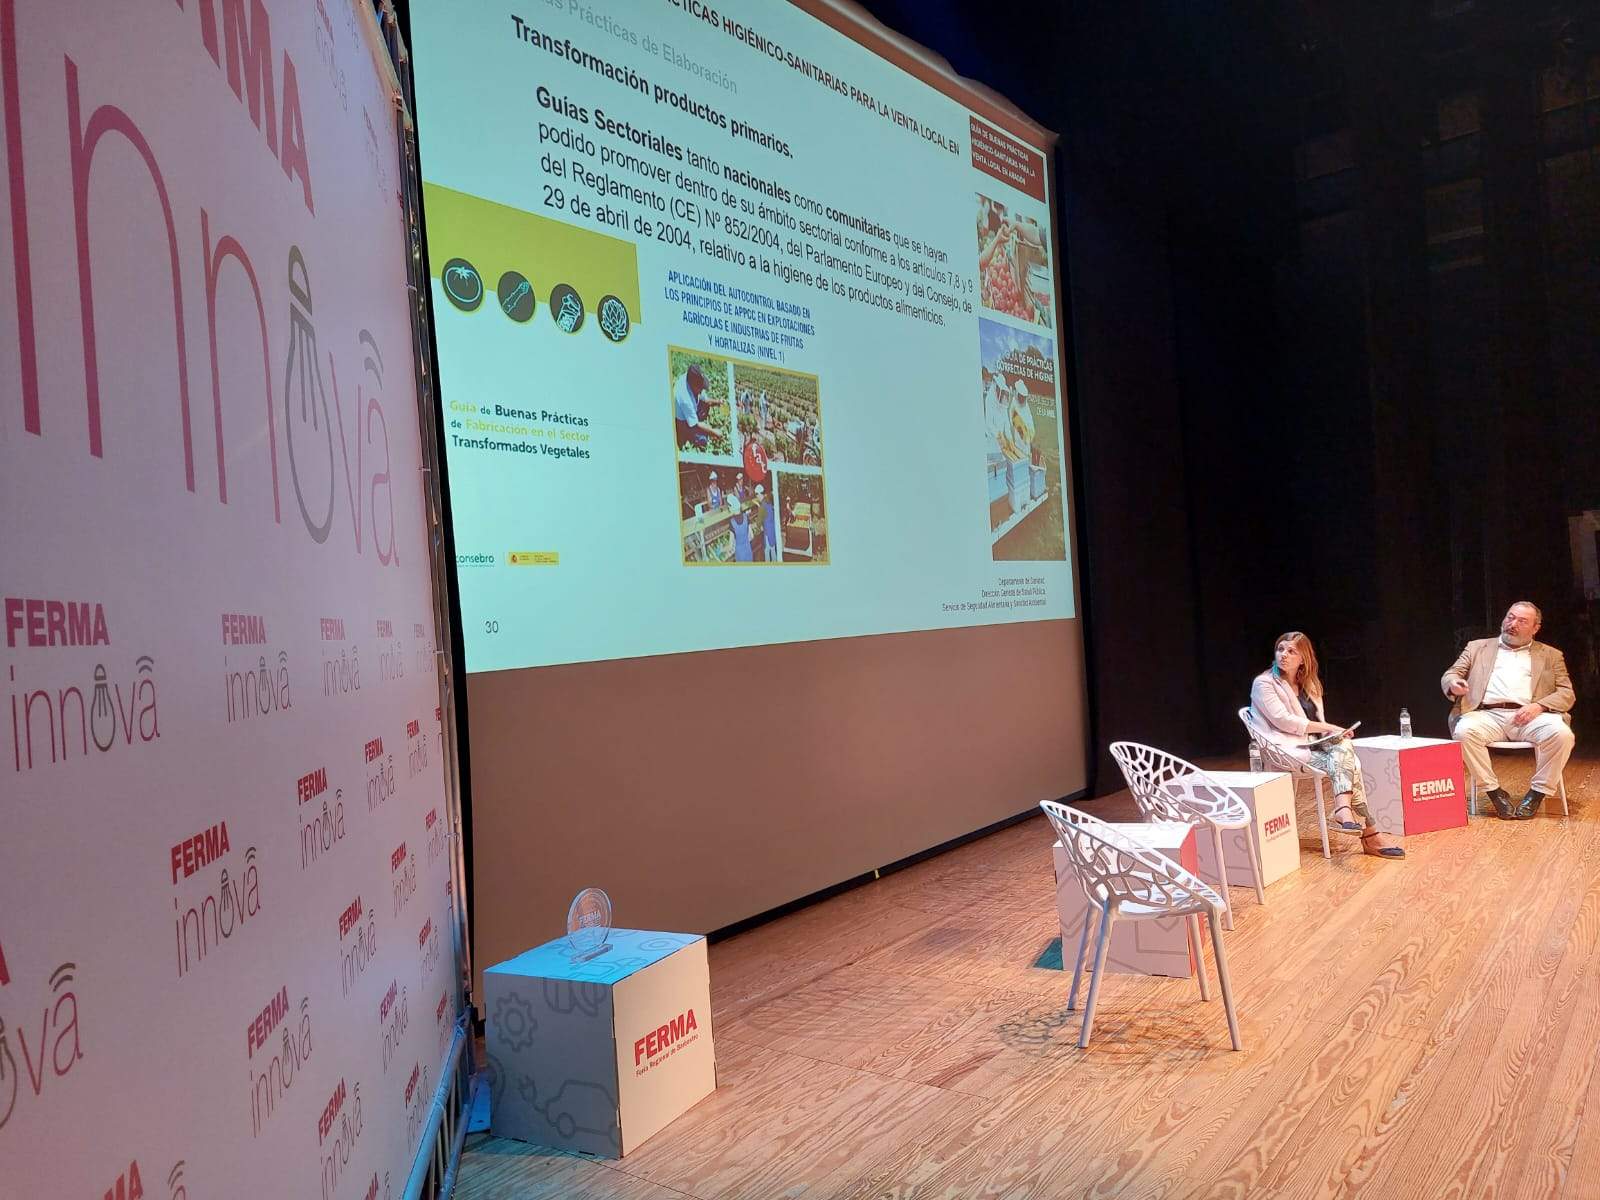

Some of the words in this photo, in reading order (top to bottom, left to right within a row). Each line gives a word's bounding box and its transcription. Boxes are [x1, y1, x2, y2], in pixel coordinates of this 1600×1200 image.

[568, 0, 638, 46] Prácticas
[641, 35, 659, 56] de
[663, 43, 738, 94] Elaboración
[511, 15, 649, 96] Transformación
[654, 84, 727, 129] productos
[731, 119, 794, 159] primarios.
[722, 16, 848, 97] HIGIÉNICO-SANITARIAS
[850, 86, 876, 113] PARA
[877, 101, 890, 120] LA
[890, 108, 919, 135] VENTA
[920, 124, 948, 150] LOCAL
[949, 139, 960, 157] EN
[536, 86, 589, 124] Guías
[594, 109, 683, 161] Sectoriales
[686, 147, 720, 176] tanto
[723, 165, 792, 204] nacionales
[794, 194, 824, 216] como
[826, 206, 892, 243] comunitarias
[893, 232, 909, 250] que
[911, 240, 922, 255] se
[923, 241, 948, 264] hayan
[538, 121, 596, 157] podido
[600, 145, 671, 184] promover
[675, 171, 718, 202] dentro
[722, 189, 737, 209] de
[740, 199, 755, 216] su
[758, 202, 797, 231] ámbito
[800, 220, 842, 248] sectorial
[844, 238, 888, 264] conforme
[890, 254, 896, 266] a
[897, 254, 910, 272] los
[912, 261, 947, 284] artículos
[968, 279, 974, 293] 9
[541, 152, 567, 179] del
[572, 161, 666, 212] Reglamento
[670, 196, 701, 229] (CE)
[705, 208, 721, 230] Nº
[724, 216, 783, 255] 852/2004,
[786, 239, 803, 259] del
[806, 244, 863, 278] Parlamento
[865, 264, 903, 291] Europeo
[904, 281, 910, 297] y
[912, 281, 924, 299] del
[962, 300, 972, 314] de
[543, 184, 565, 210] 29
[570, 194, 591, 218] de
[596, 204, 629, 231] abril
[633, 215, 652, 237] de
[656, 221, 696, 255] 2004,
[699, 239, 745, 266] relativo
[749, 255, 757, 269] a
[759, 254, 770, 274] la
[773, 258, 813, 286] higiene
[815, 273, 829, 292] de
[831, 277, 845, 297] los
[849, 286, 893, 312] productos
[895, 299, 946, 327] alimenticios.
[665, 287, 679, 302] LOS
[681, 290, 722, 313] PRINCIPIOS
[724, 303, 732, 315] DE
[734, 306, 756, 320] APPCC
[758, 311, 766, 324] EN
[768, 313, 815, 336] EXPLOTACIONES
[668, 270, 712, 292] APLICACIÓN
[714, 282, 727, 296] DEL
[728, 286, 775, 311] AUTOCONTROL
[776, 302, 801, 317] BASADO
[803, 307, 811, 319] EN
[683, 310, 723, 331] AGRÍCOLAS
[725, 321, 729, 332] E
[731, 322, 769, 341] INDUSTRIAS
[771, 330, 779, 343] DE
[781, 333, 804, 350] FRUTAS
[708, 334, 712, 346] Y
[714, 337, 755, 355] HORTALIZAS
[757, 346, 777, 361] (NIVEL
[779, 351, 785, 365] 1)
[451, 420, 462, 429] de
[531, 428, 544, 436] en
[547, 428, 556, 438] el
[560, 430, 590, 442] Sector
[480, 406, 491, 415] de
[495, 404, 537, 421] Buenas
[541, 410, 589, 427] Prácticas
[452, 435, 538, 455] Transformados
[540, 443, 590, 459] Vegetales
[4, 597, 110, 648] FERMA
[221, 614, 266, 645] FERMA
[320, 618, 345, 640] FERMA
[485, 621, 499, 634] 30
[364, 736, 383, 764] FERMA
[297, 768, 328, 805] FERMA
[1412, 778, 1455, 797] FERMA
[1264, 813, 1290, 838] FERMA
[170, 820, 231, 885] FERMA
[339, 896, 363, 940] FERMA
[248, 985, 290, 1060] FERMA
[380, 978, 398, 1025] FERMA
[634, 1008, 698, 1067] FERMA
[318, 1077, 346, 1147] FERMA
